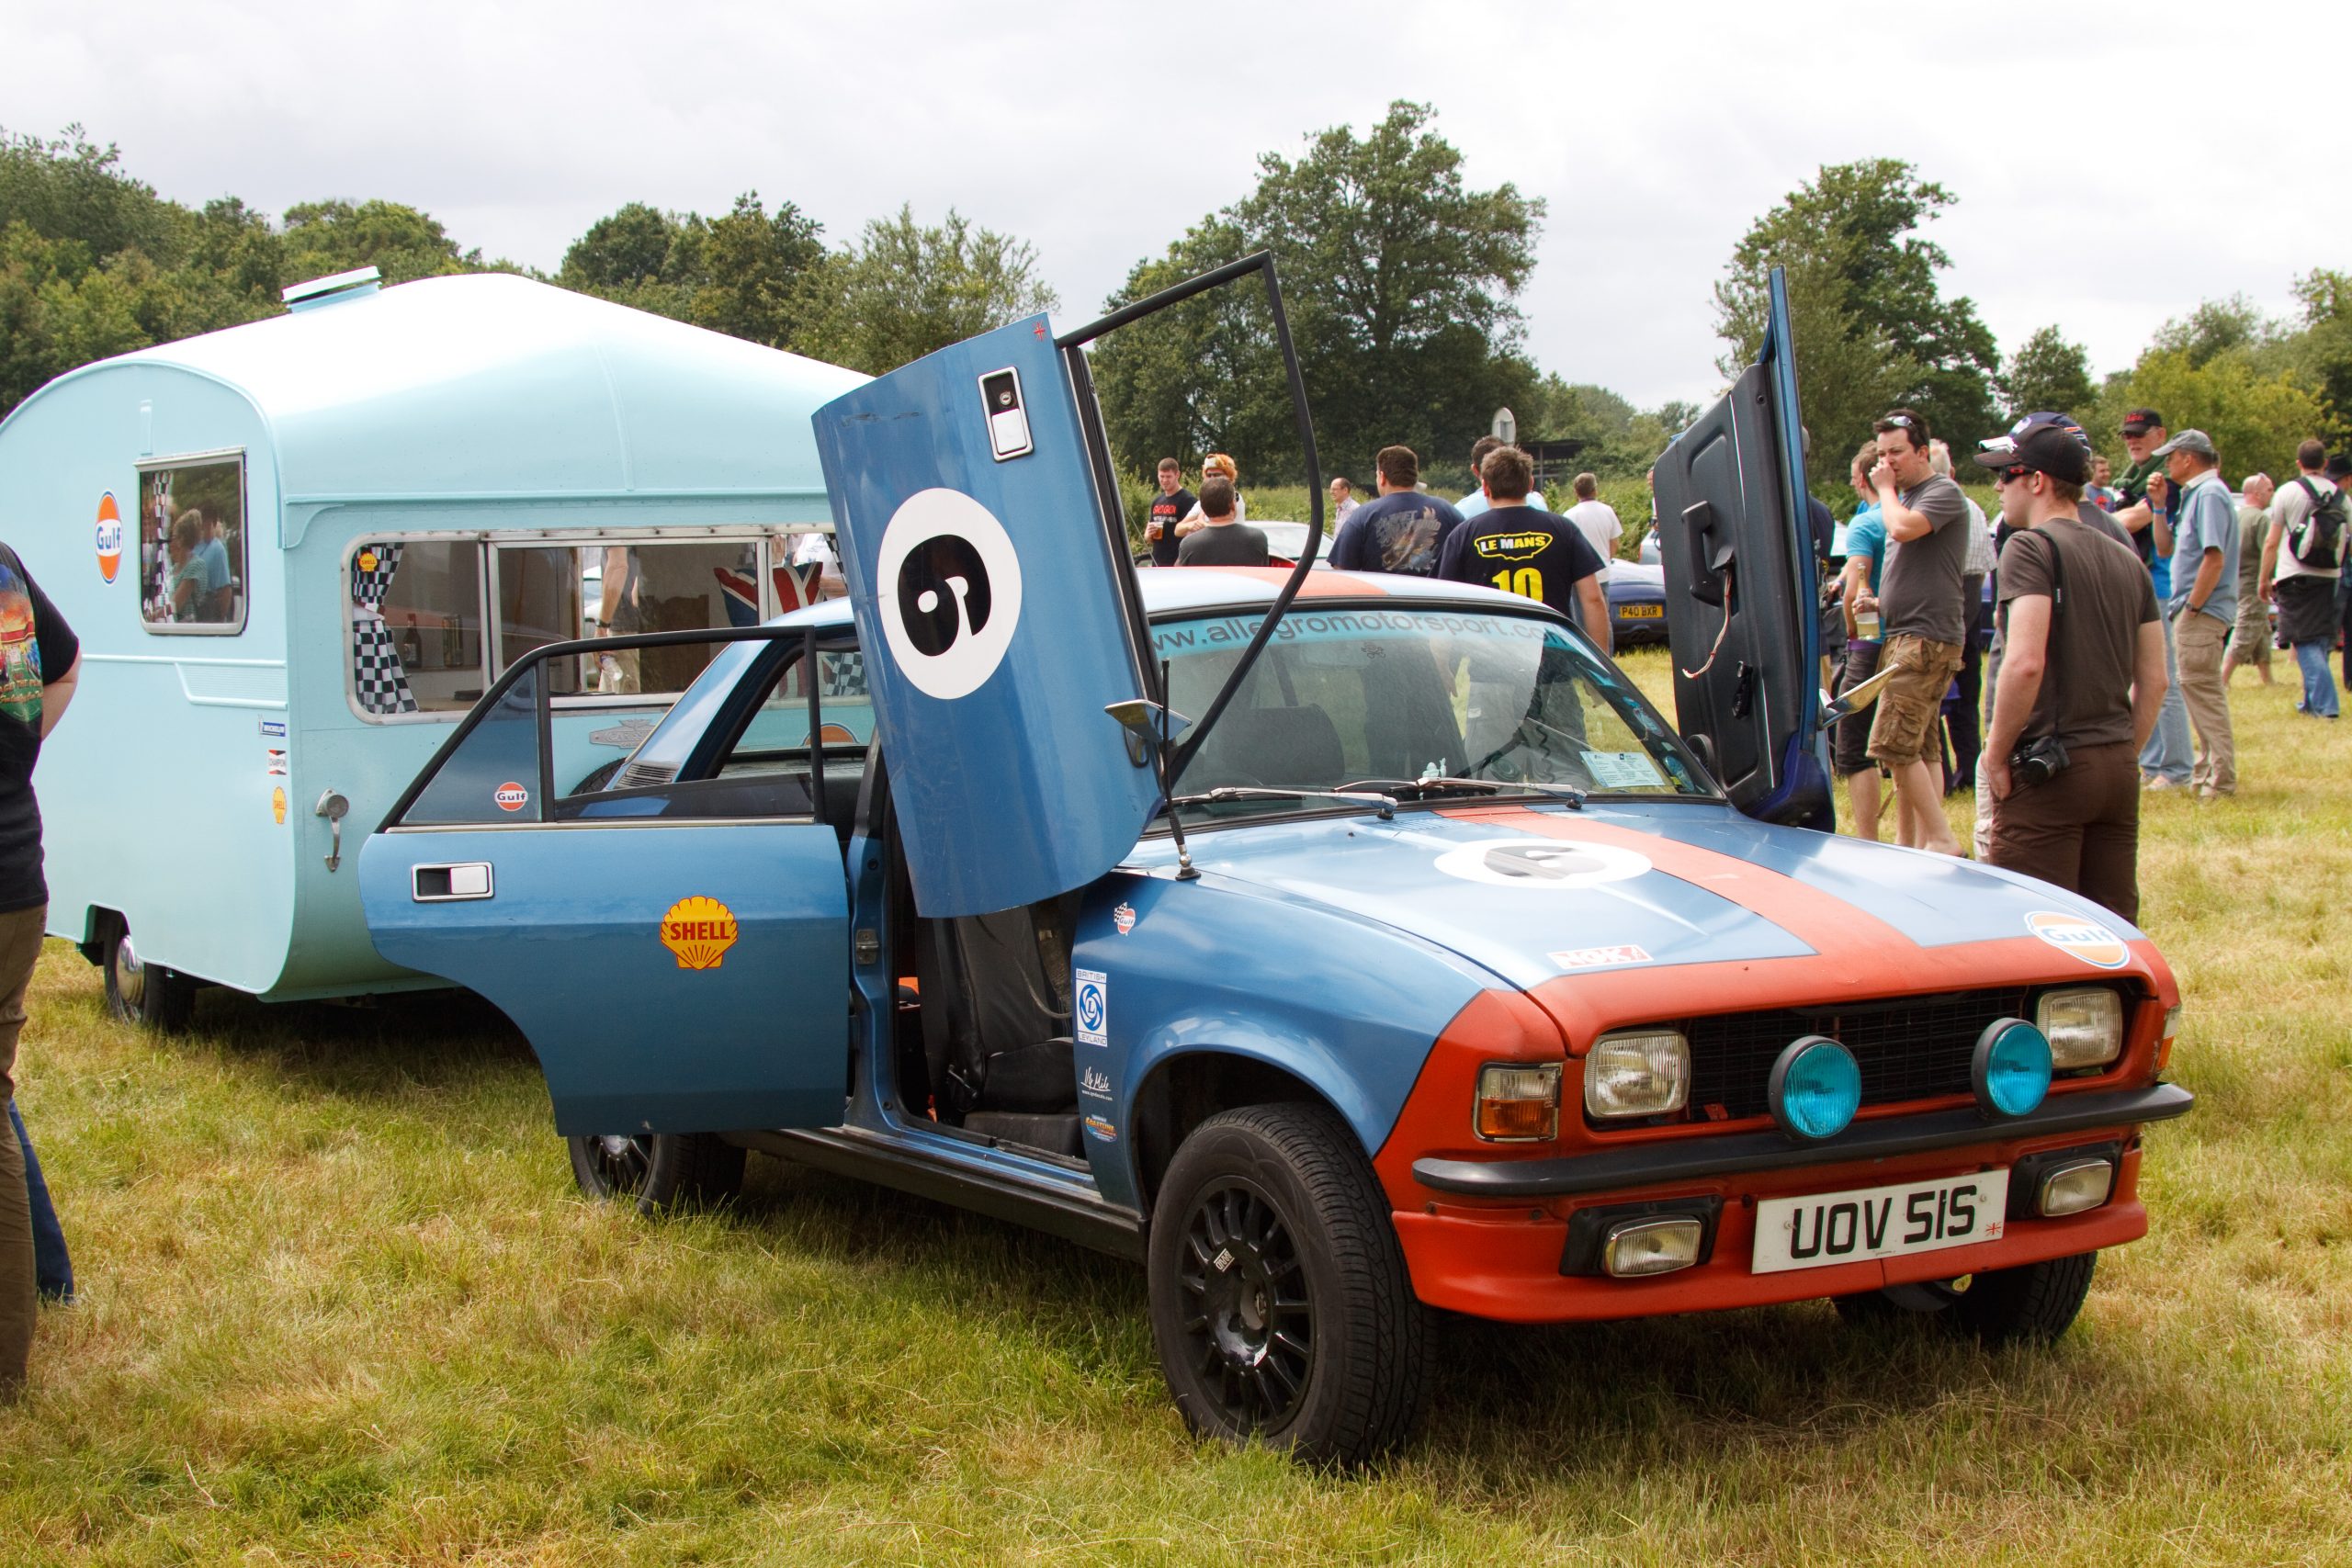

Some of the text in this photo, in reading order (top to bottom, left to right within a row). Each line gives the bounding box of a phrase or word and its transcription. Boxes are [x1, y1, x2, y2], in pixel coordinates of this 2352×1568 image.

[96, 525, 121, 550] Gulf
[1480, 536, 1547, 553] LE MANS
[1492, 567, 1544, 604] 10
[898, 534, 992, 657] 6
[1622, 606, 1640, 617] P40
[496, 792, 526, 801] Gulf
[1118, 917, 1135, 926] Gulf
[670, 921, 730, 942] SHELL
[2041, 928, 2115, 942] Gulf
[1077, 970, 1106, 981] BRITISH
[1079, 1032, 1107, 1046] LEYLAND
[1791, 1197, 1893, 1259] UOV
